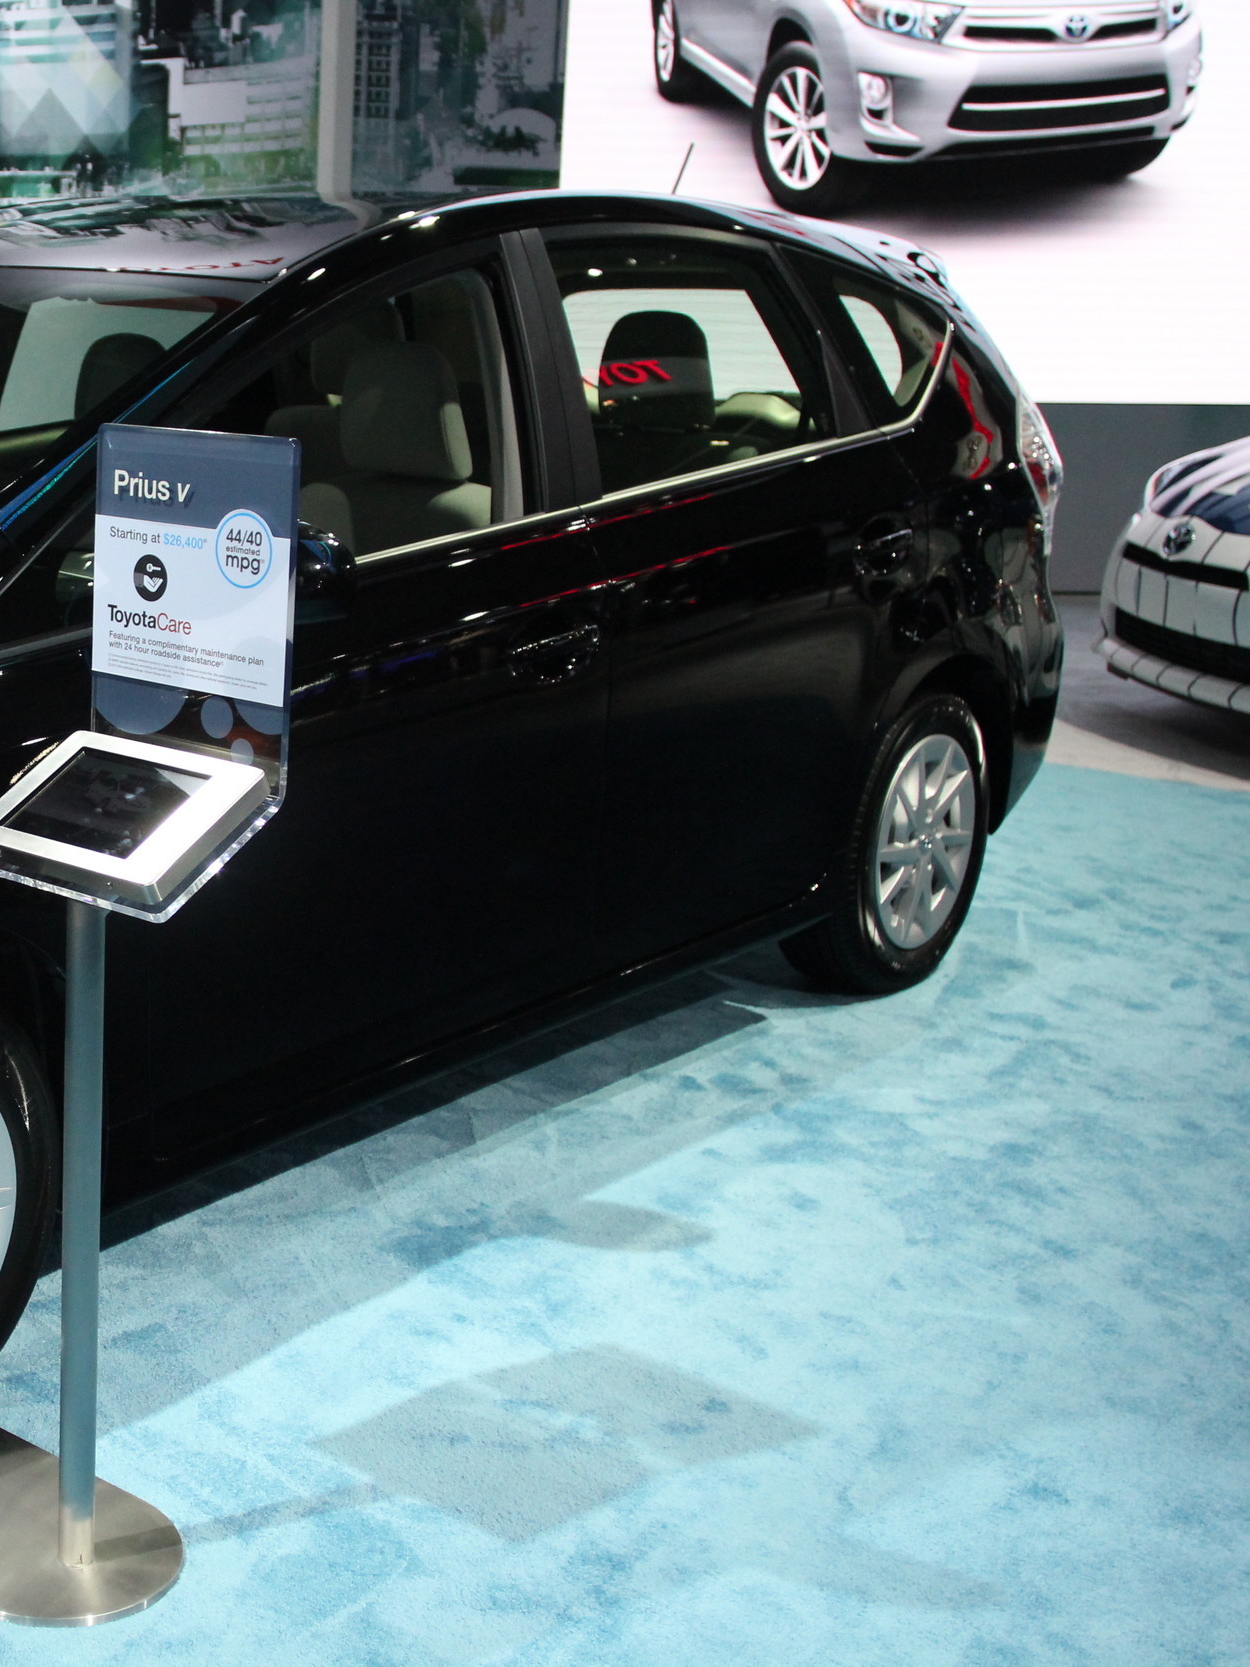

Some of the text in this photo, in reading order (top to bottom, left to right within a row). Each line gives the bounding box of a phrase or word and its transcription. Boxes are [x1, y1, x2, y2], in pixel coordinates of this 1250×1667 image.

[113, 469, 170, 501] Prius
[110, 525, 148, 545] Starting
[150, 533, 161, 544] at
[225, 528, 263, 547] 44/40
[225, 545, 261, 557] estimated
[225, 554, 261, 576] mpg
[107, 603, 192, 635] ToyotaCare
[108, 630, 141, 645] Featuring
[147, 639, 199, 656] complimentary
[200, 648, 247, 663] maintenance
[247, 656, 264, 667] plan
[108, 640, 221, 668] with 24 hour roadside assistance
